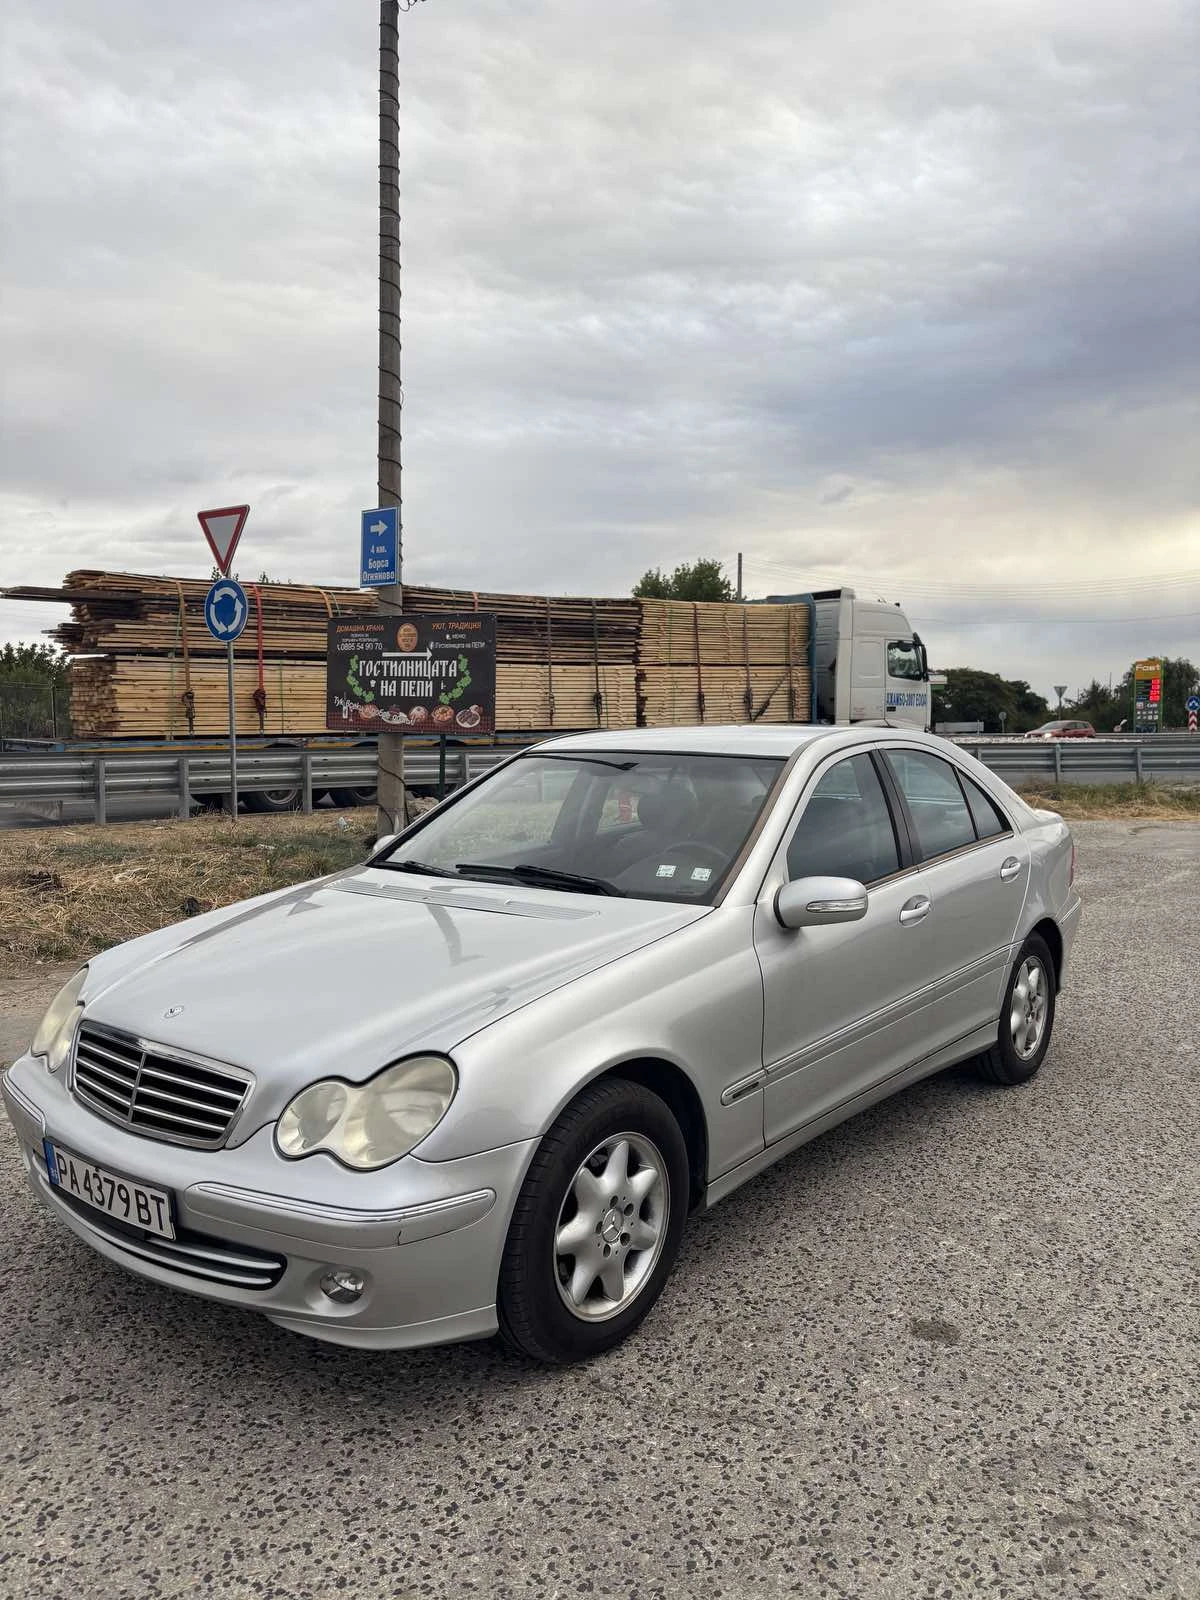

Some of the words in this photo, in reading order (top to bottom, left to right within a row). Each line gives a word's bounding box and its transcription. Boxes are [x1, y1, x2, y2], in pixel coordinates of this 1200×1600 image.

[370, 544, 375, 554] 4
[368, 558, 389, 571] Борса
[363, 571, 395, 581] Огняново
[359, 660, 457, 680] ГОСТИЛНИЦАТА
[380, 680, 396, 697] НА
[401, 680, 433, 697] ПЕПИ
